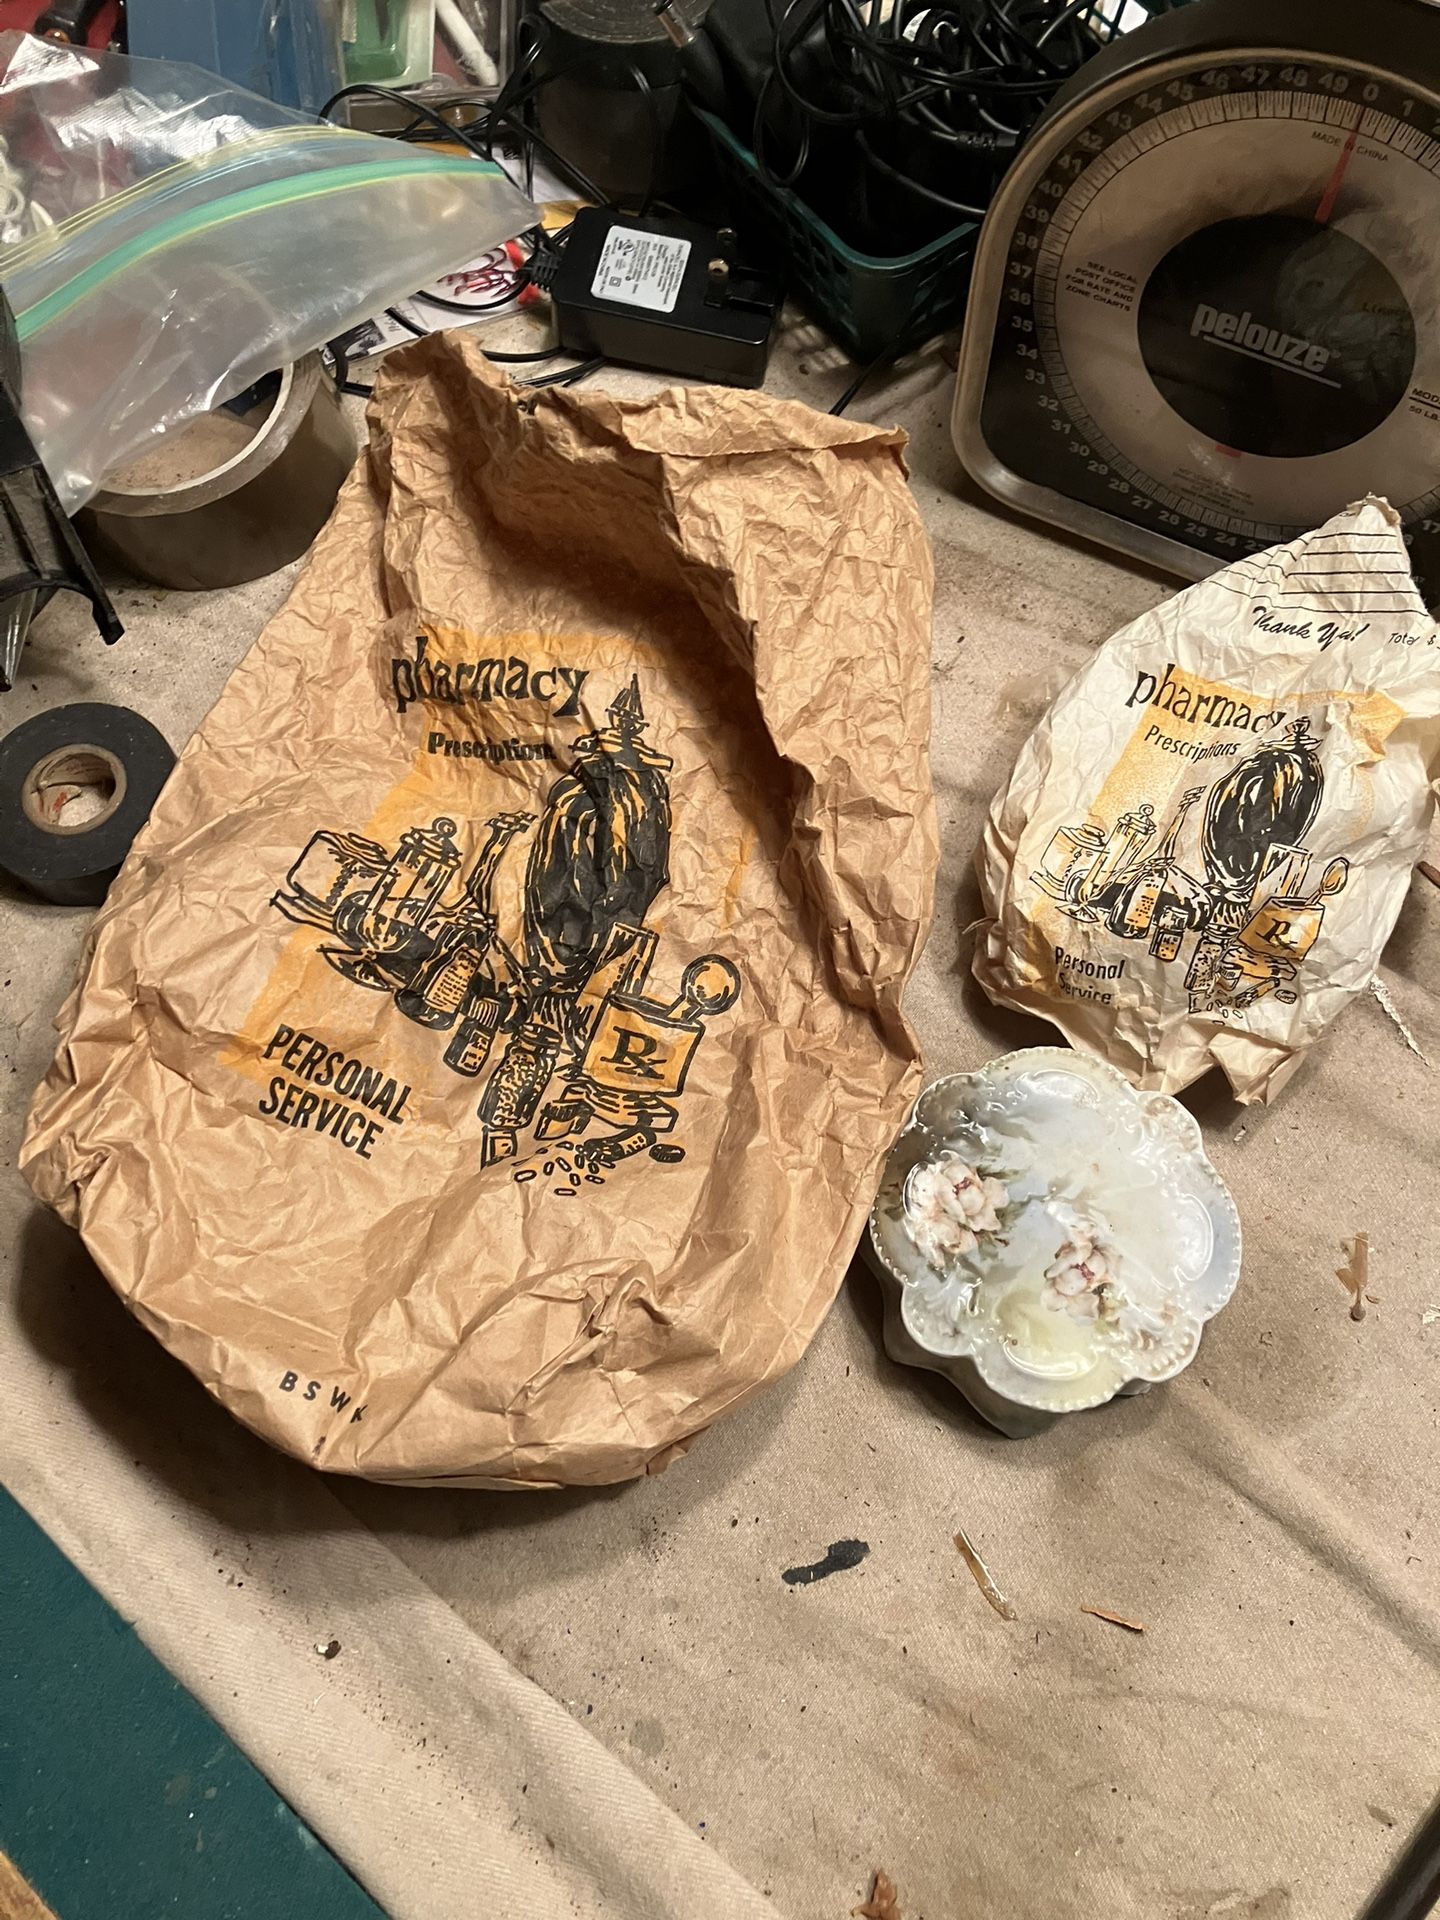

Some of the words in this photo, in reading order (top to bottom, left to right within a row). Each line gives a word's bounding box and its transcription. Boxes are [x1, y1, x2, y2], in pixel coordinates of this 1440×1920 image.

[1201, 70, 1229, 89] 46
[1241, 66, 1269, 85] 47
[1279, 66, 1308, 86] 48
[1318, 72, 1348, 93] 49
[1166, 80, 1194, 100] 45
[1363, 83, 1379, 100] 0
[1135, 93, 1162, 113] 44
[1403, 100, 1414, 117] 1
[1106, 112, 1132, 130] 43
[1077, 131, 1104, 149] 42
[1312, 130, 1342, 146] MADE
[1356, 146, 1388, 161] CHINA
[1058, 155, 1082, 174] 41
[1038, 180, 1063, 197] 40
[1025, 205, 1049, 222] 39
[1016, 232, 1038, 249] 38
[1010, 262, 1032, 278] 37
[1087, 261, 1105, 272] SEE
[1065, 274, 1084, 284] FOR
[1087, 281, 1110, 294] RATE
[1113, 291, 1133, 302] AND
[1075, 267, 1101, 280] POST
[1103, 277, 1135, 293] OFFICE
[1009, 289, 1031, 305] 36
[1065, 285, 1090, 297] ZONE
[1093, 294, 1130, 311] CHARTS
[1011, 316, 1033, 332] 35
[1190, 303, 1331, 373] pelouze
[1016, 344, 1038, 359] 34
[1025, 369, 1045, 384] 33
[1038, 395, 1059, 411] 32
[1412, 388, 1440, 404] MOD
[1051, 420, 1071, 434] 31
[1069, 441, 1090, 456] 30
[1087, 460, 1108, 475] 29
[1108, 477, 1130, 494] 28
[1131, 496, 1153, 510] 27
[1158, 510, 1180, 525] 26
[1184, 522, 1208, 537] 25
[1214, 531, 1237, 547] 24
[1253, 606, 1313, 639] Thank
[391, 636, 589, 717] pharmacy
[1124, 663, 1287, 733] pharmacy
[1144, 724, 1241, 764] Prescriptions
[1055, 946, 1125, 979] Personal
[262, 1023, 412, 1124] PERSONAL
[259, 1076, 384, 1160] SERVICE
